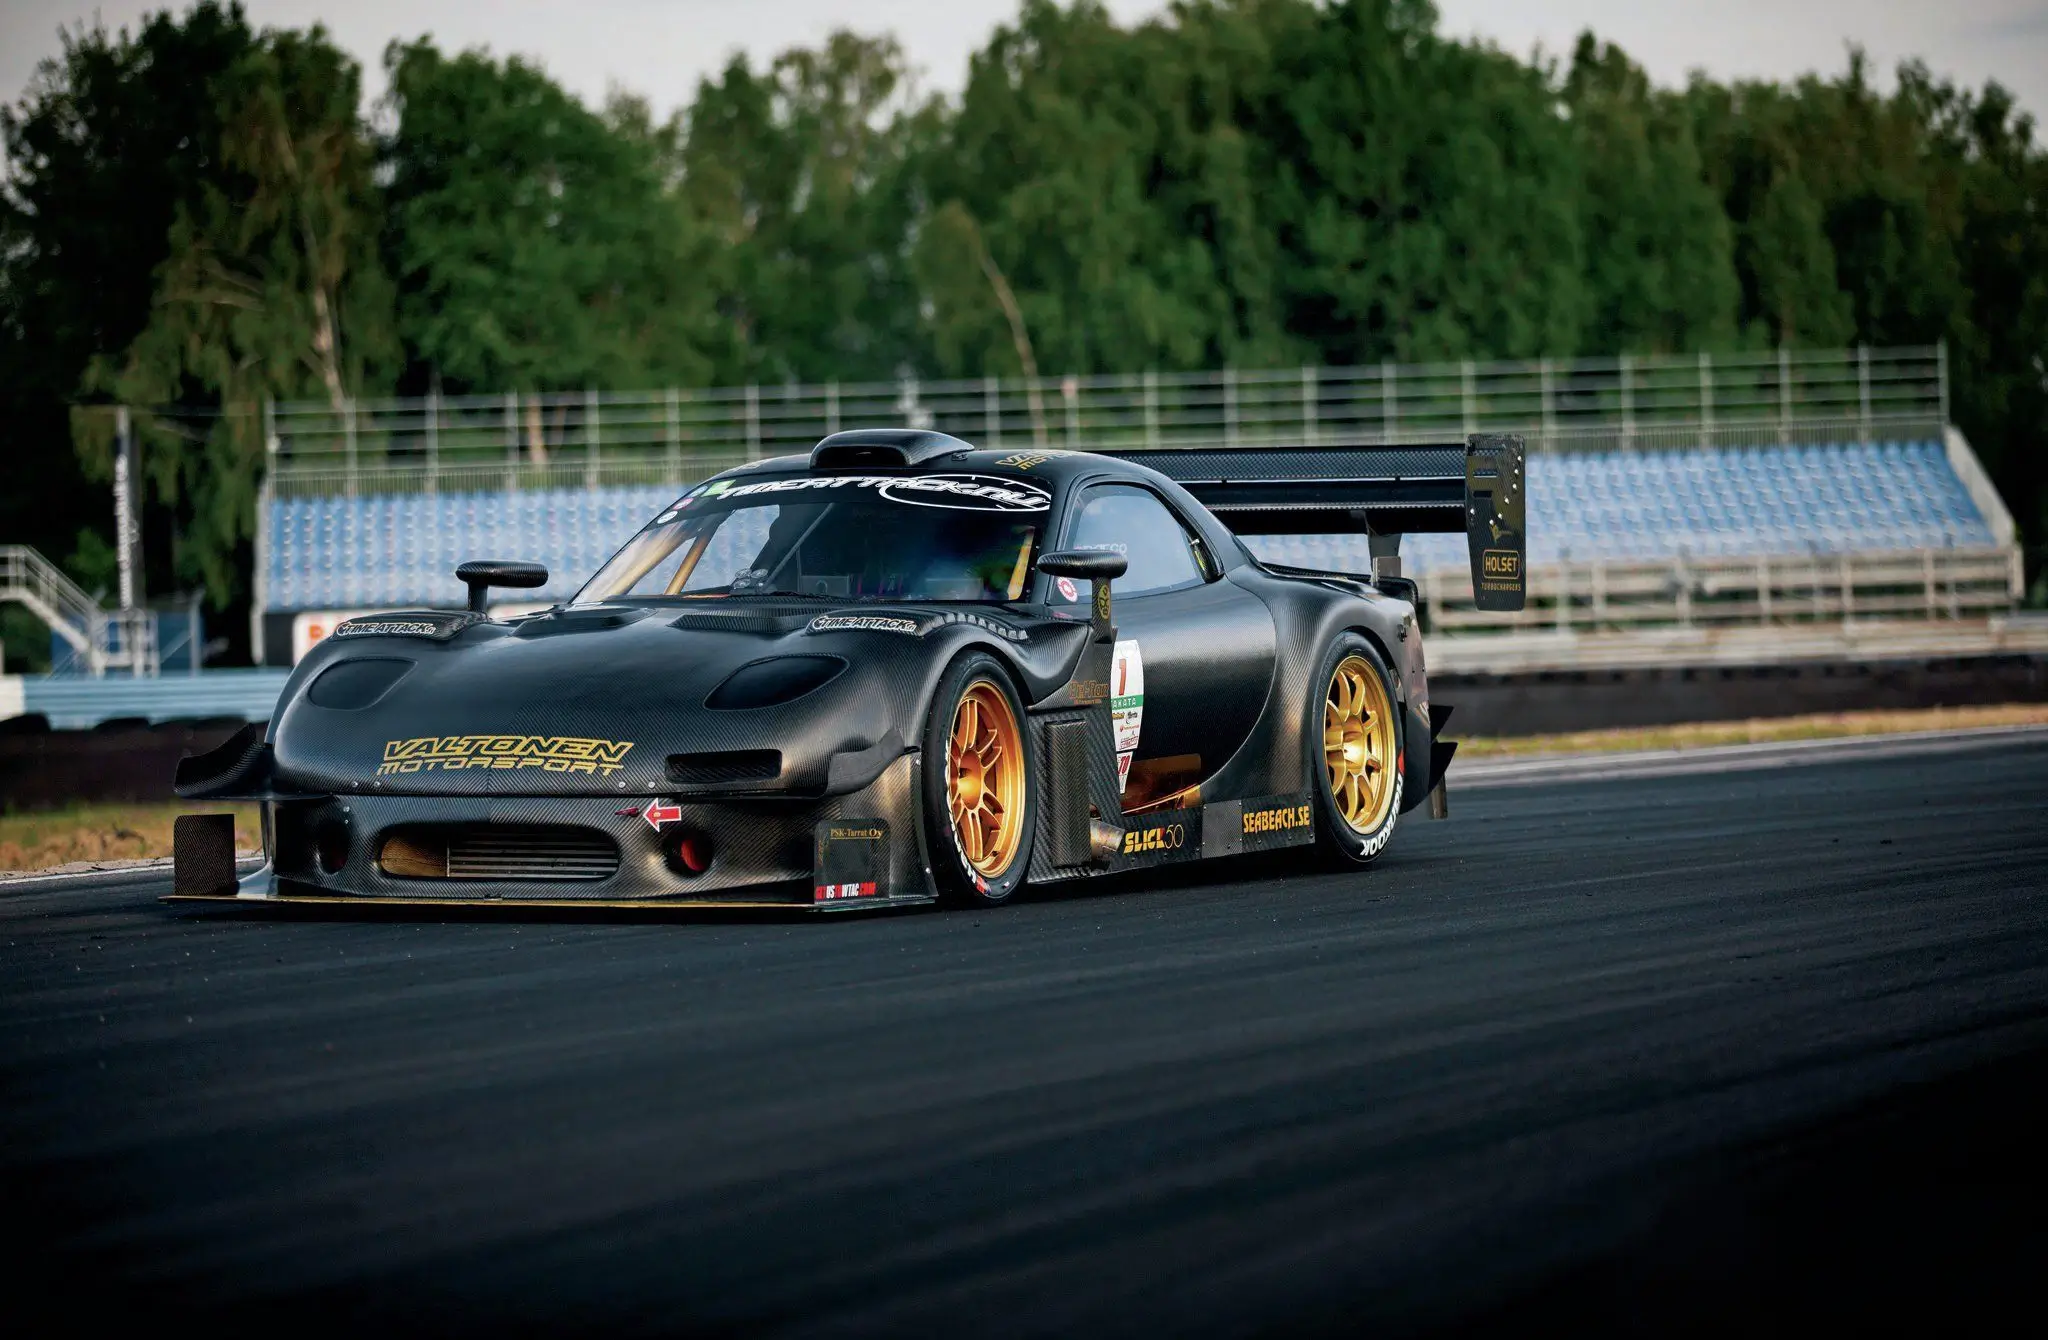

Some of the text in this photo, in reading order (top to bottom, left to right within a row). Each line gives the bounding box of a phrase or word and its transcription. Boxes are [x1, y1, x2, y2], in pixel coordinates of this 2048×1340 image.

[1486, 557, 1517, 572] HOLSET
[1481, 582, 1521, 592] TURBOCHARGERS
[1112, 697, 1136, 708] AKATA
[384, 736, 634, 762] VALTONEN
[377, 757, 624, 776] MOTORSPORT
[1243, 806, 1310, 833] SEABEACH.SE
[869, 828, 883, 838] Oy
